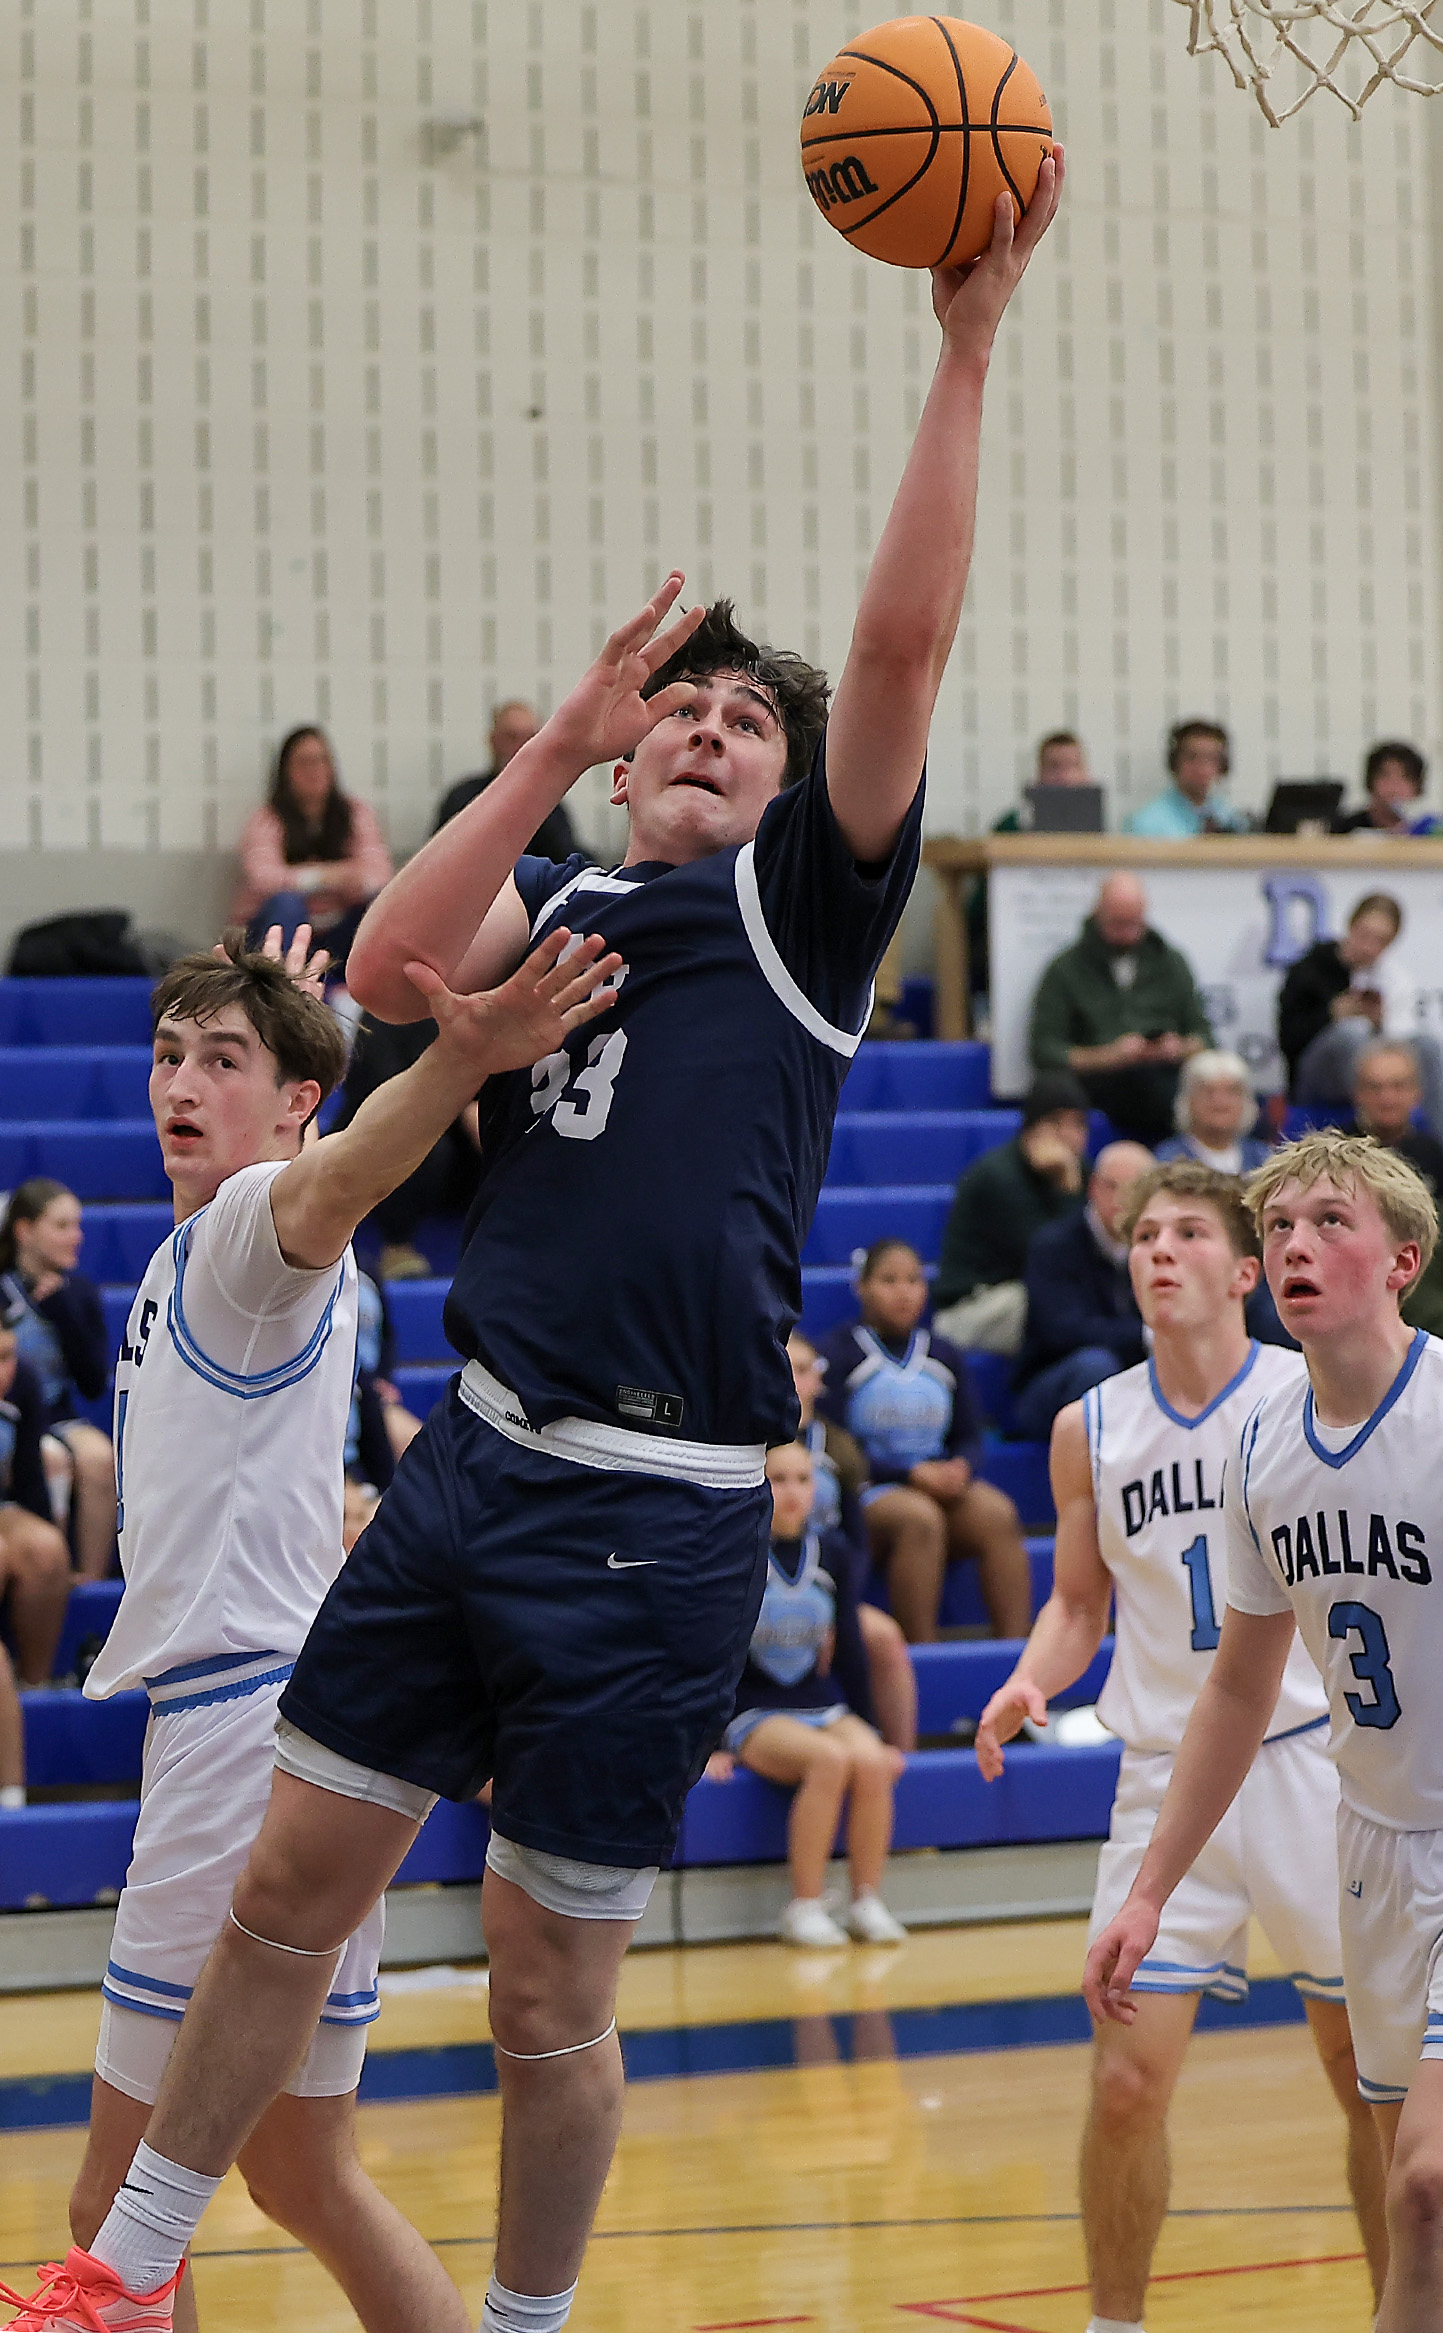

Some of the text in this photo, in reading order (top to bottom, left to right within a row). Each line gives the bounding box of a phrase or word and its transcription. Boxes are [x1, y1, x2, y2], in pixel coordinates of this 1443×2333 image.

[664, 1402, 671, 1416] L
[1121, 1459, 1227, 1538] DALL
[1271, 1510, 1433, 1586] DALLAS
[1182, 1534, 1221, 1651] 1
[1328, 1601, 1402, 1729] 3
